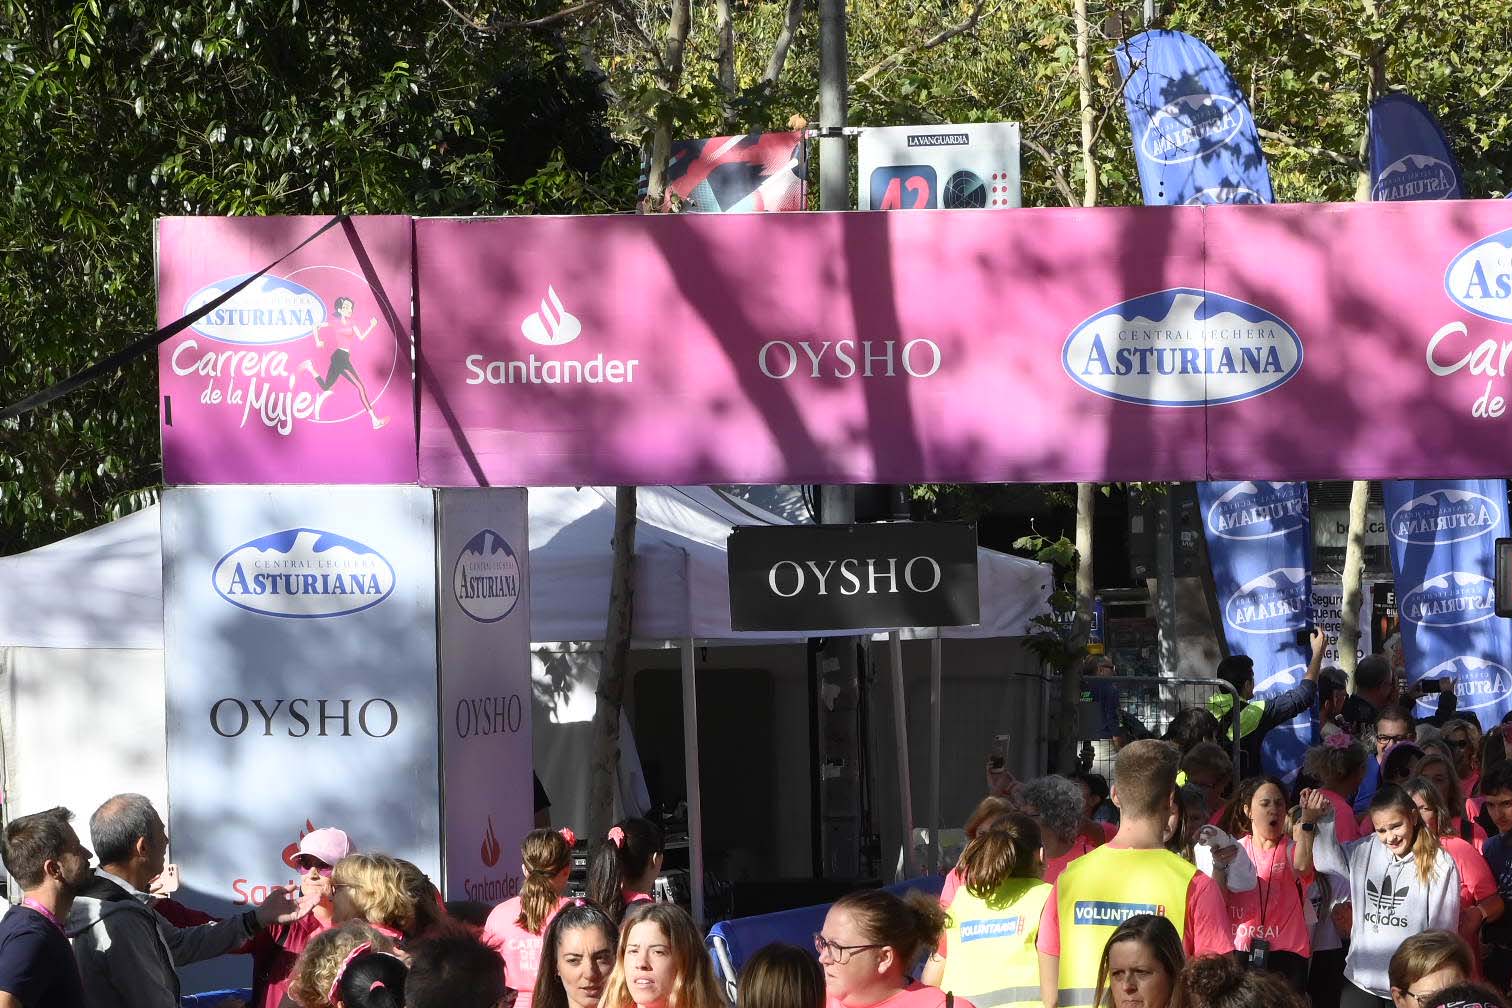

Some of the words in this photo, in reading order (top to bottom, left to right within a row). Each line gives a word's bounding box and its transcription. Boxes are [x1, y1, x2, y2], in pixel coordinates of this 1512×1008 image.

[908, 136, 919, 146] LA
[918, 134, 968, 145] VANGUARDIA
[1118, 327, 1192, 342] CENTRAL
[171, 339, 290, 378] Carrera
[465, 351, 639, 386] Santander
[758, 338, 941, 381] OYSHO
[1080, 332, 1284, 377] ASTURIANA
[200, 378, 223, 405] de
[226, 378, 243, 405] la
[240, 374, 335, 436] Mujer
[1471, 382, 1507, 419] de
[226, 561, 383, 596] ASTURIANA
[254, 559, 313, 569] CENTRAL
[459, 565, 517, 600] ASTURIANA
[768, 555, 942, 598] OYSHO
[209, 697, 399, 738] OYSHO
[455, 693, 522, 739] OYSHO
